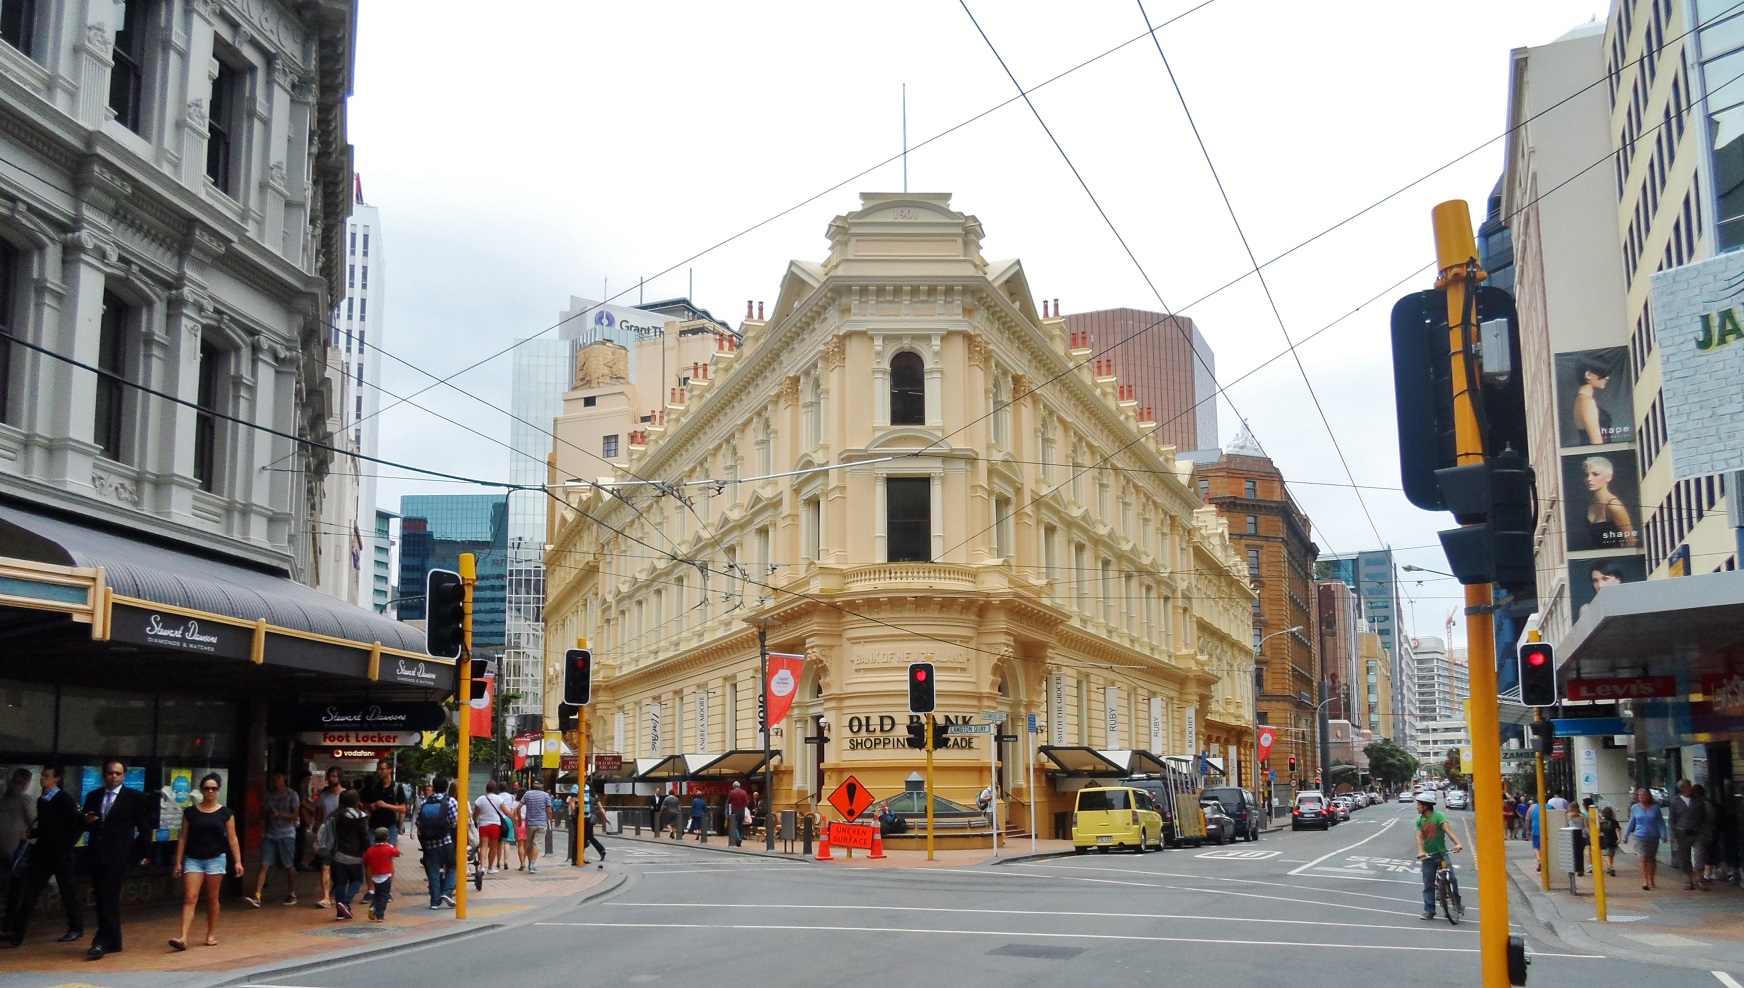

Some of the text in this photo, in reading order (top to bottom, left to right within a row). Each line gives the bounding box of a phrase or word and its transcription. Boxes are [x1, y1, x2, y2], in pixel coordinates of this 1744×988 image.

[893, 209, 918, 220] 1901
[620, 319, 652, 335] Grant
[1694, 303, 1744, 350] JA
[1600, 426, 1629, 435] hape
[1602, 530, 1638, 539] shape
[146, 614, 218, 644] Stewart Dawsons
[147, 637, 181, 647] DIAMONDS
[322, 705, 407, 722] Stewart Dawsons
[848, 714, 896, 734] OLD
[1108, 707, 1117, 732] RUBY
[322, 731, 398, 743] Foot Locker
[849, 737, 906, 750] SHOPPIN
[343, 749, 376, 757] vodafone
[1502, 752, 1536, 760] ZAMBE
[836, 827, 867, 836] UNEVEN
[833, 835, 868, 846] SURFACE
